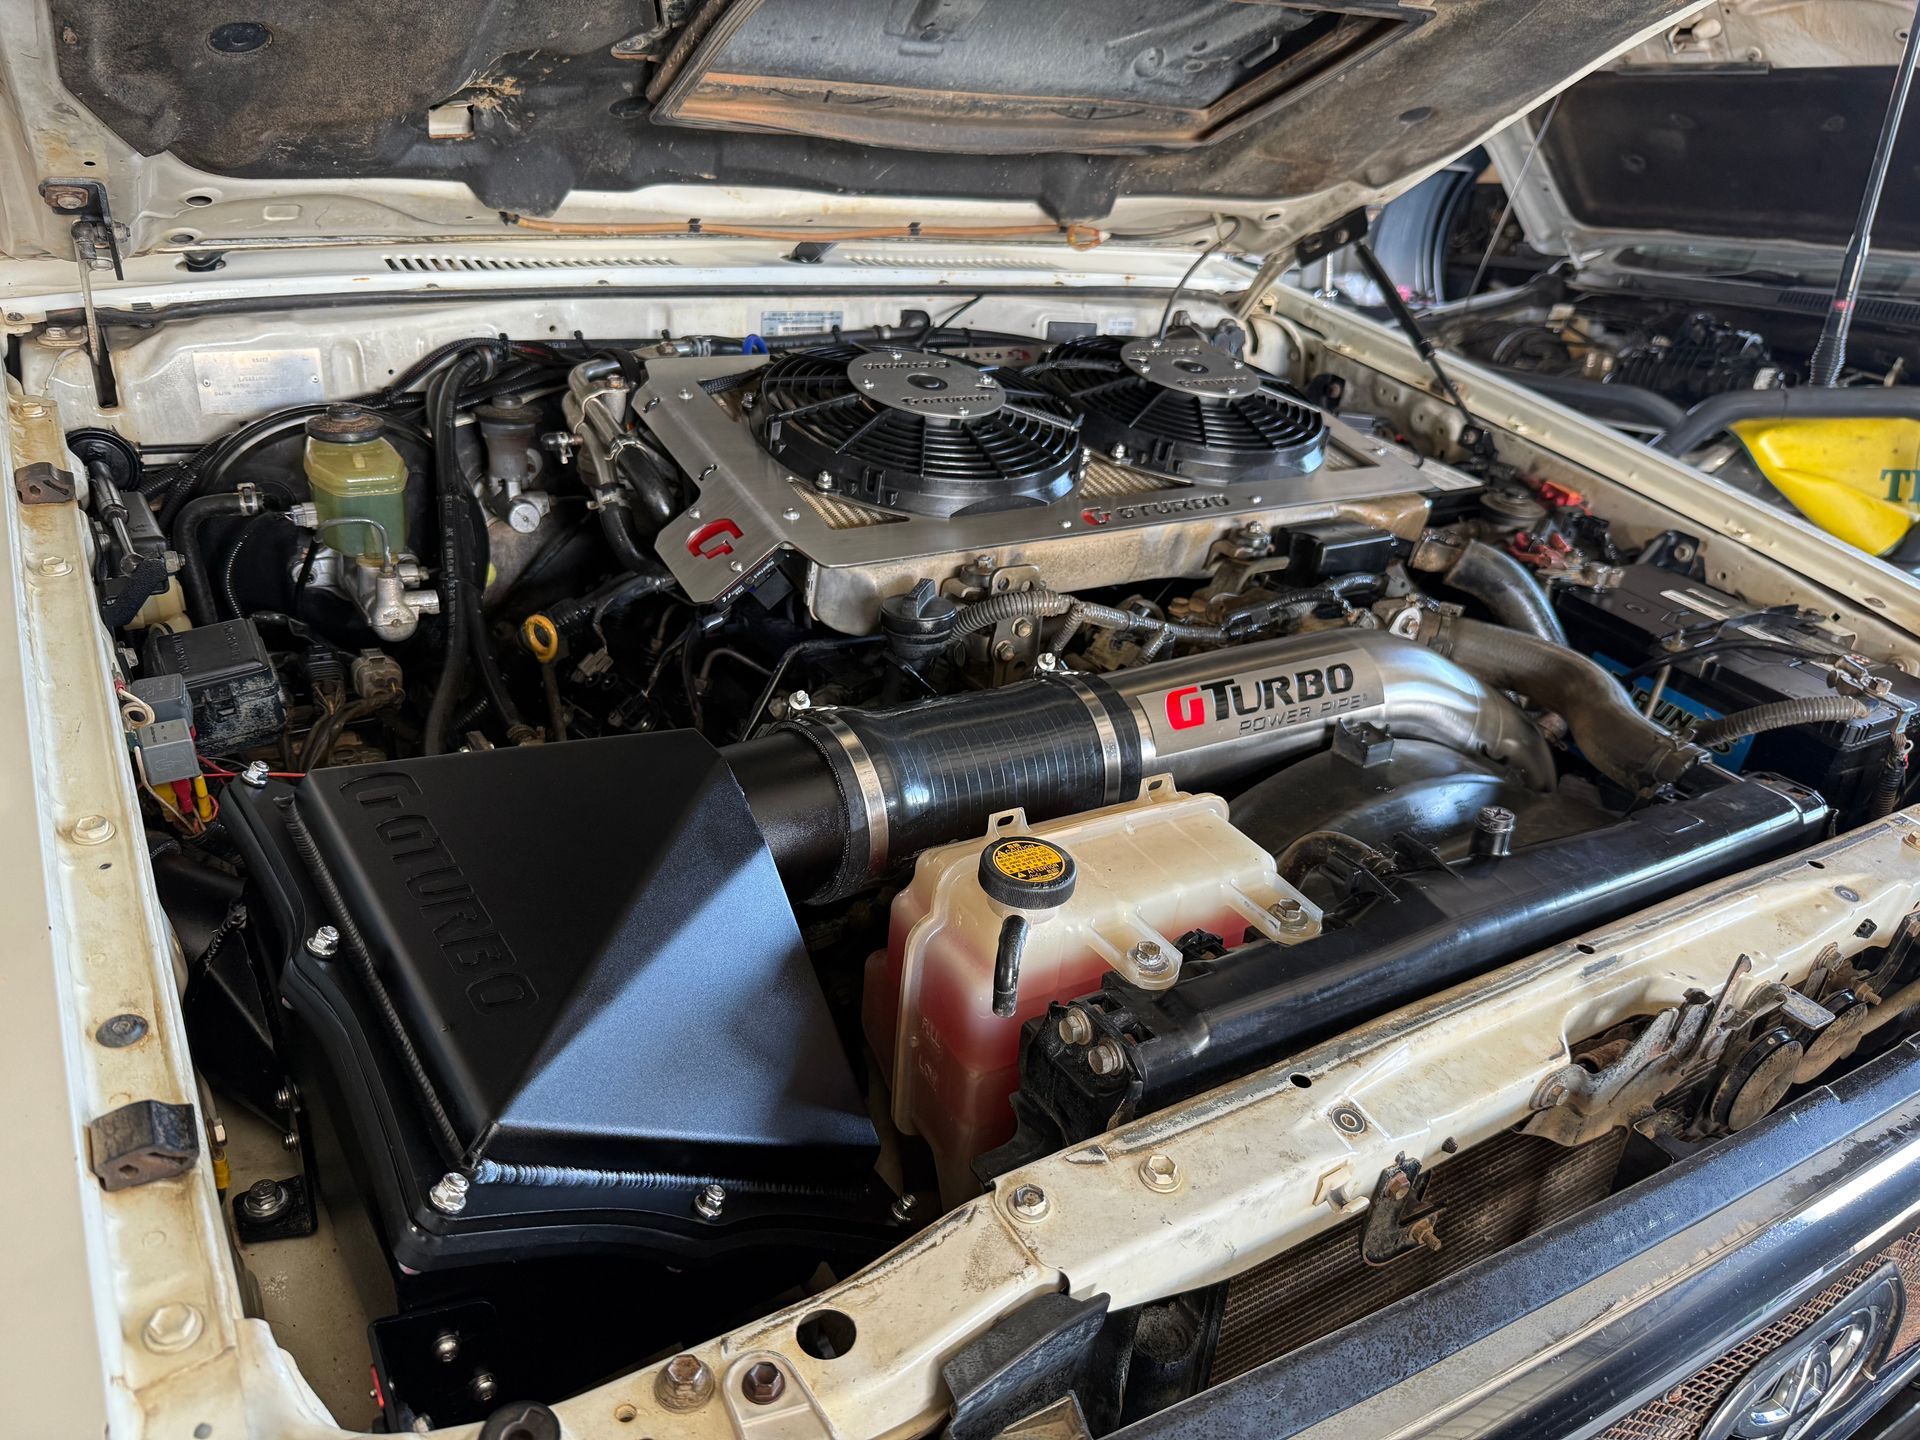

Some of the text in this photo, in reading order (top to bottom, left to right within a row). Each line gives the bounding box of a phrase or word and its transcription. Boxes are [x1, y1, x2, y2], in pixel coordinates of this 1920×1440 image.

[1116, 493, 1231, 520] GTURBO
[1165, 662, 1355, 732] GTURBO
[1239, 693, 1362, 736] POWER PIPE
[374, 813, 541, 1018] GTURBO
